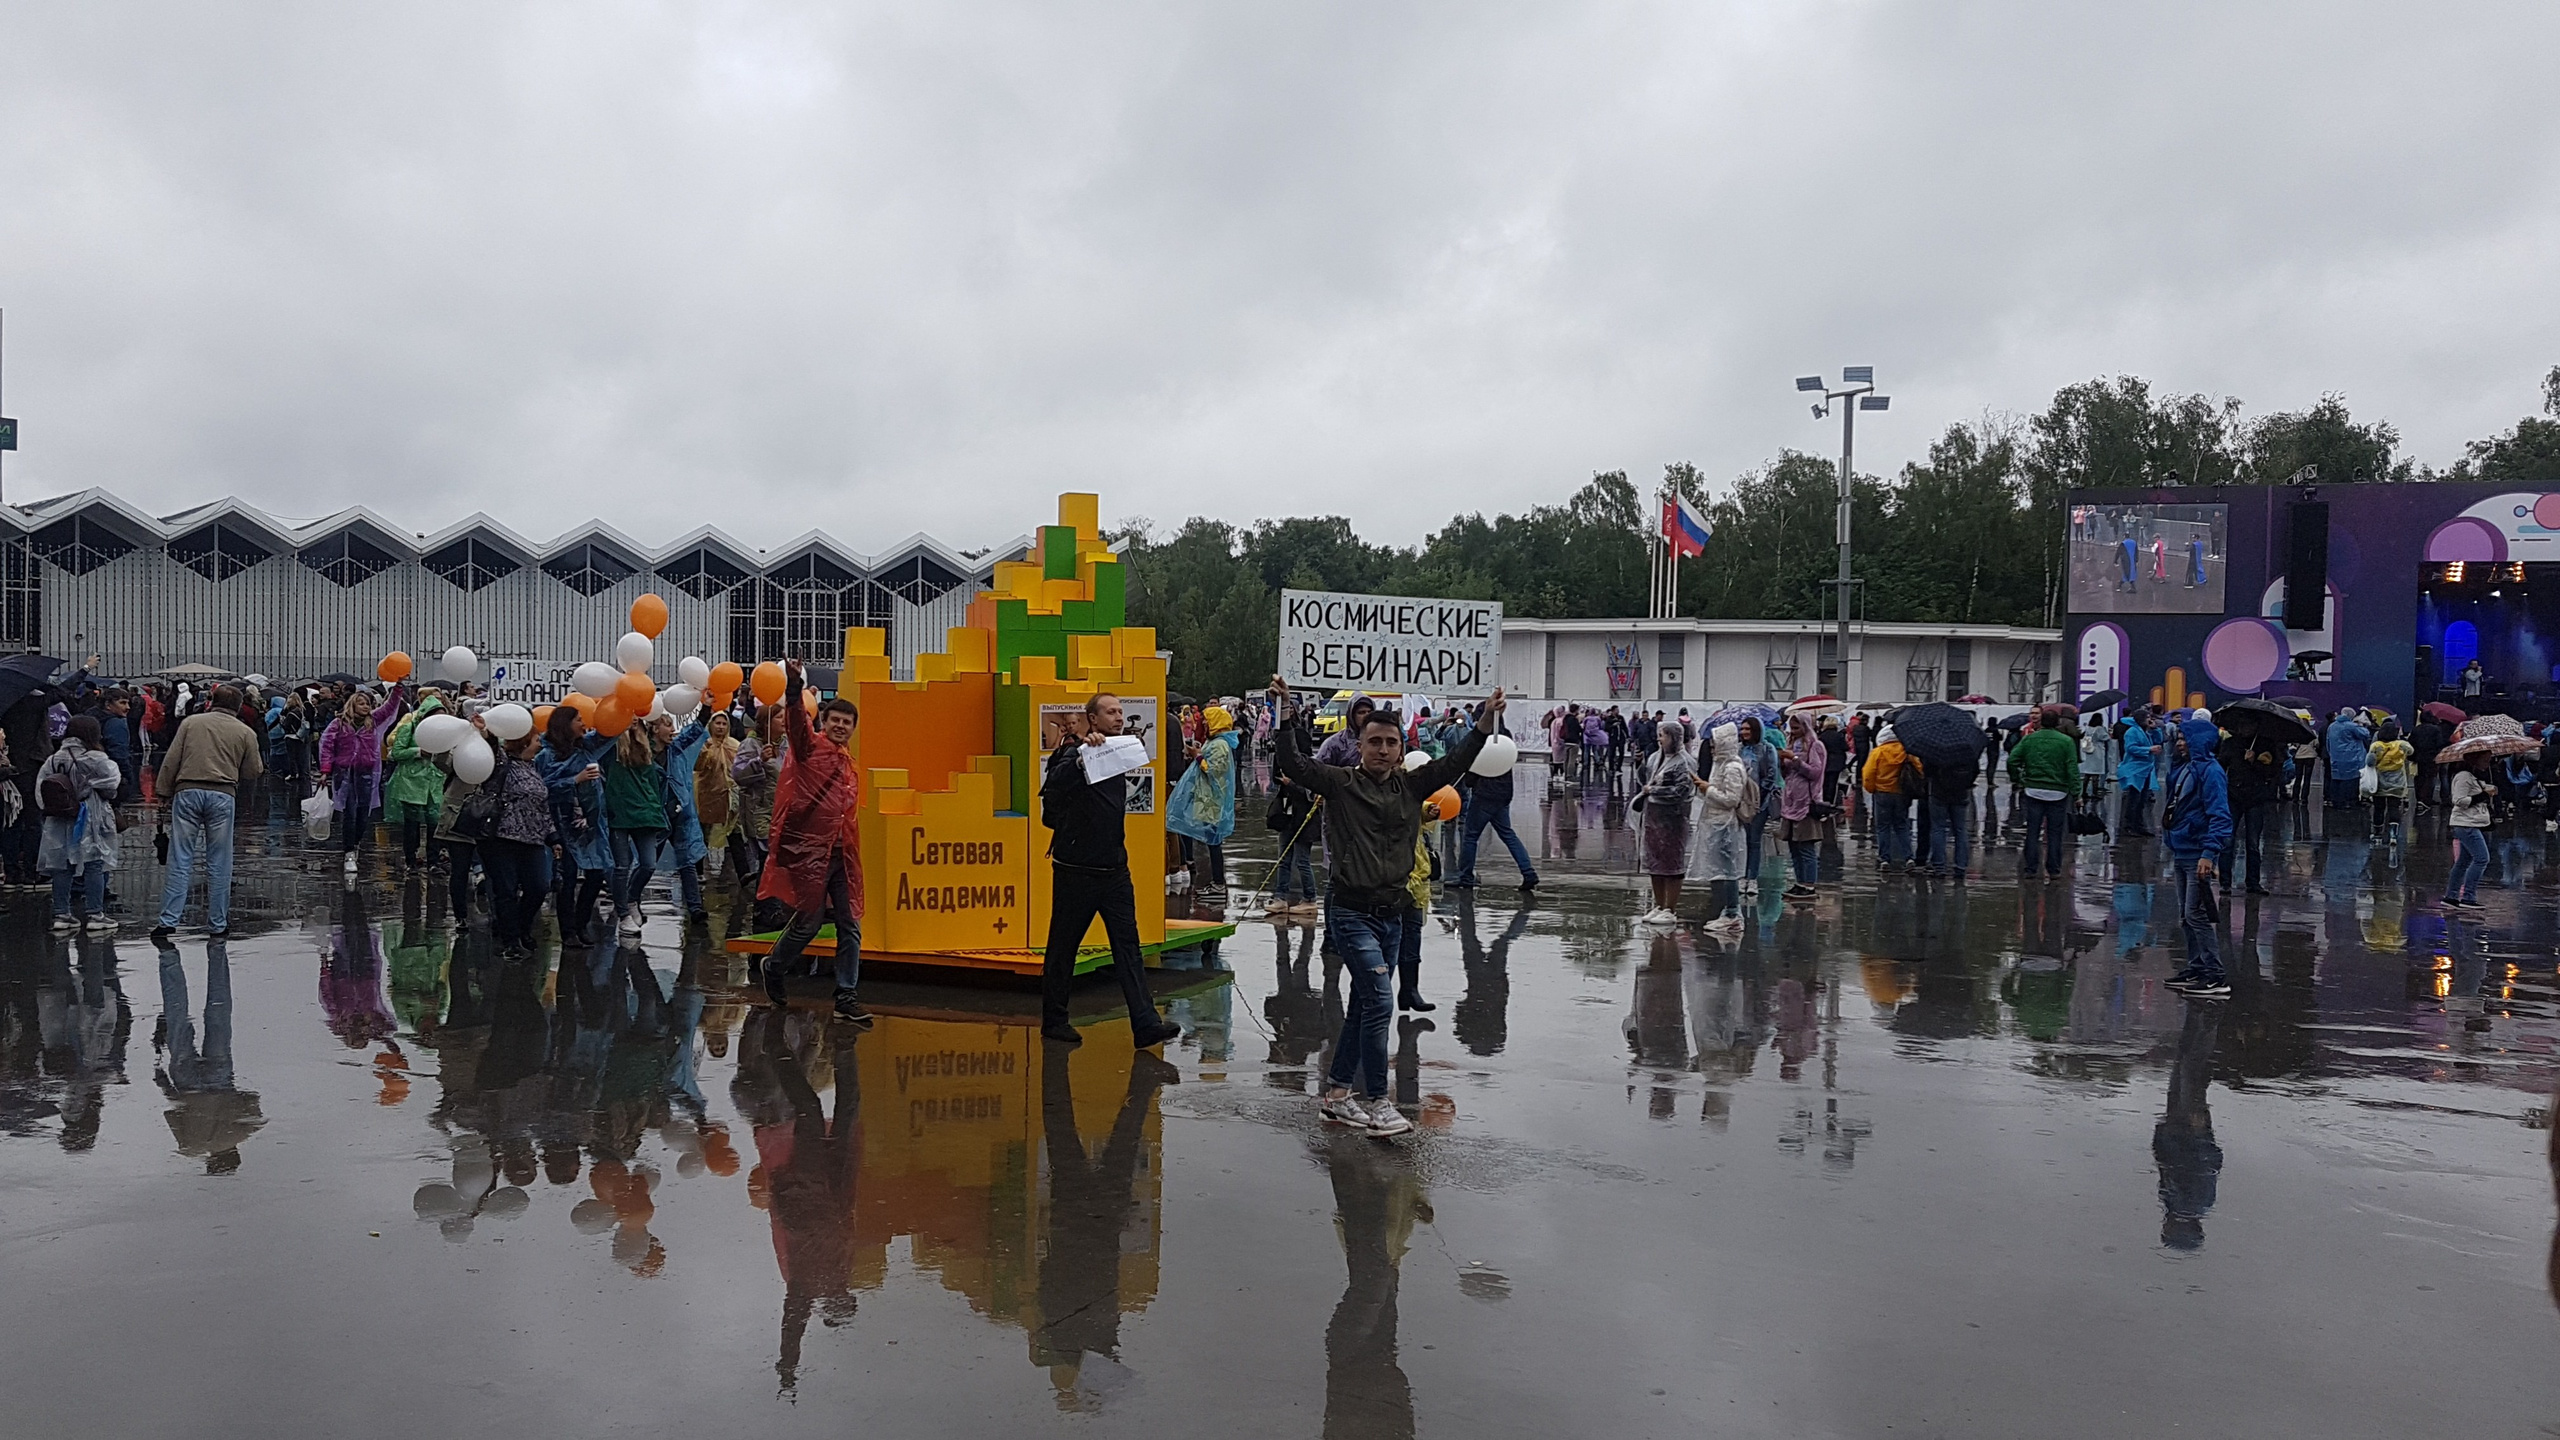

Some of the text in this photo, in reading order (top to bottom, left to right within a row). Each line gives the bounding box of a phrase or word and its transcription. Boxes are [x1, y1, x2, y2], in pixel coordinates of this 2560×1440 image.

[1288, 598, 1490, 638] КОСМИЧЕСКИЕ
[1301, 642, 1480, 686] ВЕБИНАРЫ
[911, 827, 1003, 865] Сетевая
[896, 872, 1015, 913] Академия
